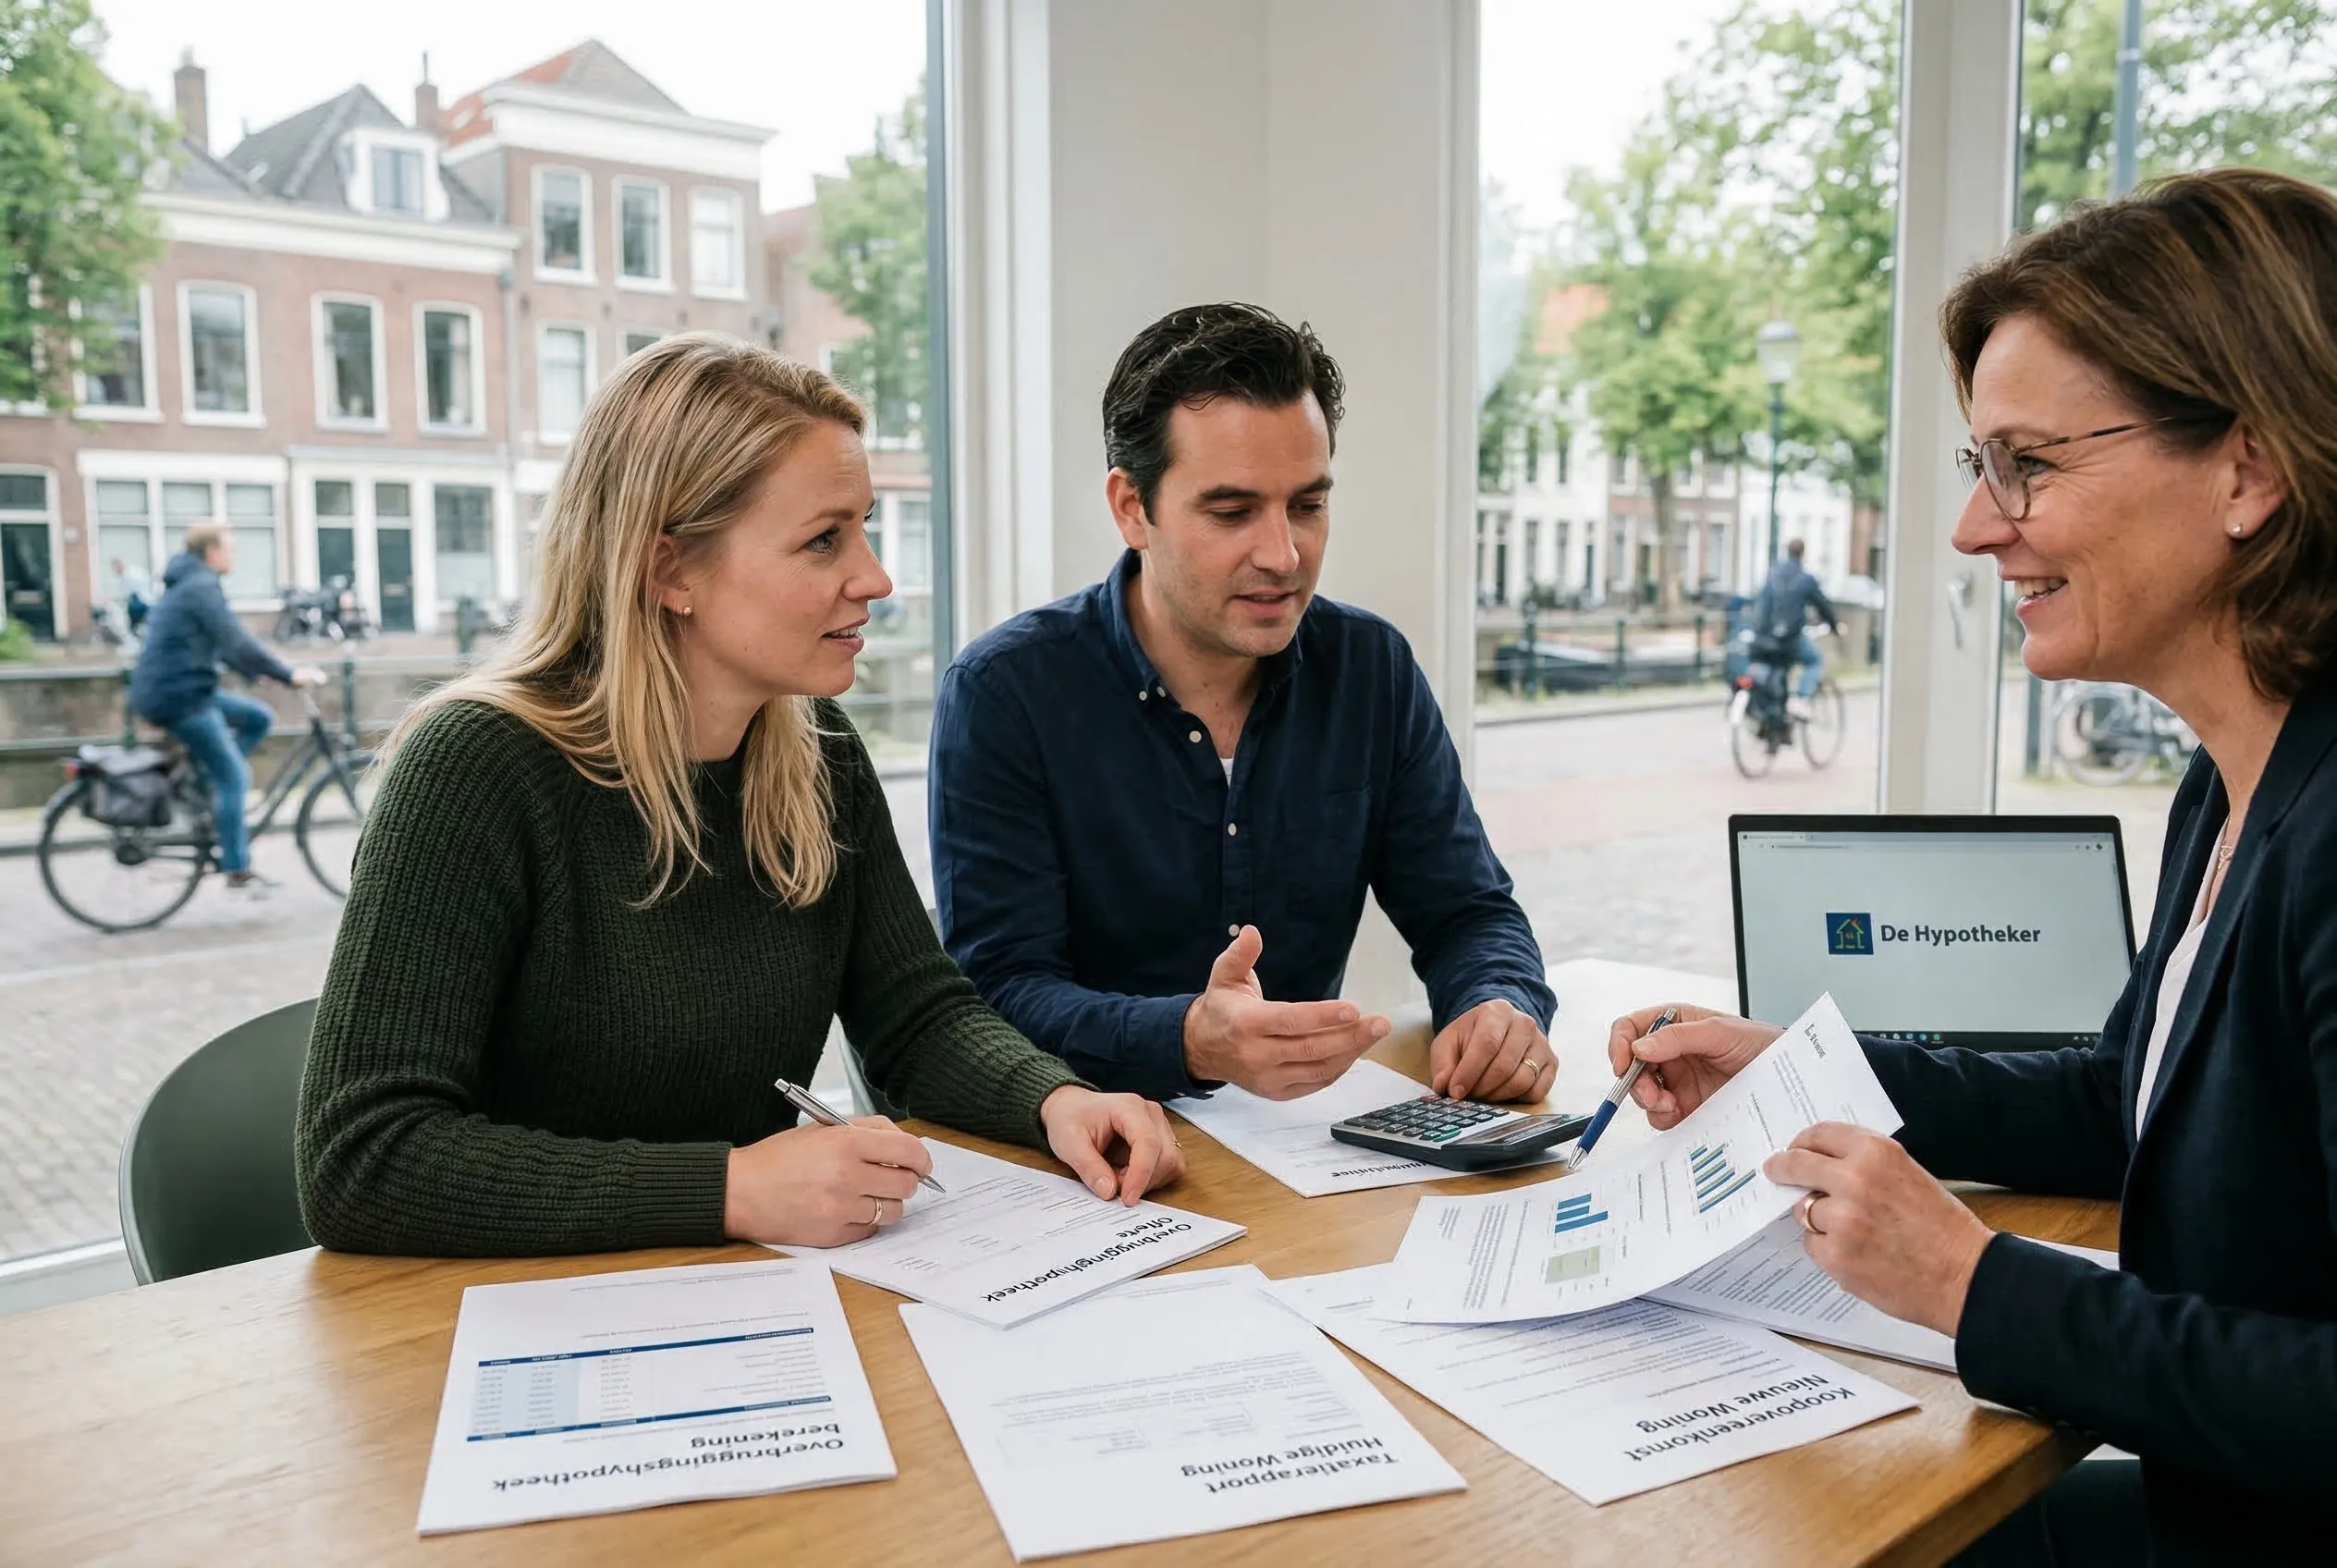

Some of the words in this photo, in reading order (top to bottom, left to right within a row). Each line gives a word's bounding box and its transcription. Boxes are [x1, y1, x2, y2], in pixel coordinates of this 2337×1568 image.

[1880, 925, 1909, 942] De
[1915, 925, 2040, 946] Hypotheker
[1734, 1374, 1829, 1405] Nieuwe
[1624, 1387, 1856, 1461] Koopovereenkomst
[1636, 1403, 1739, 1433] Woning
[691, 1423, 840, 1448] berekening
[1286, 1437, 1383, 1459] Huidige
[493, 1438, 843, 1491] Overbruggingshypotheek
[1181, 1454, 1282, 1476] Woning
[1205, 1452, 1399, 1493] Taxatierapport
